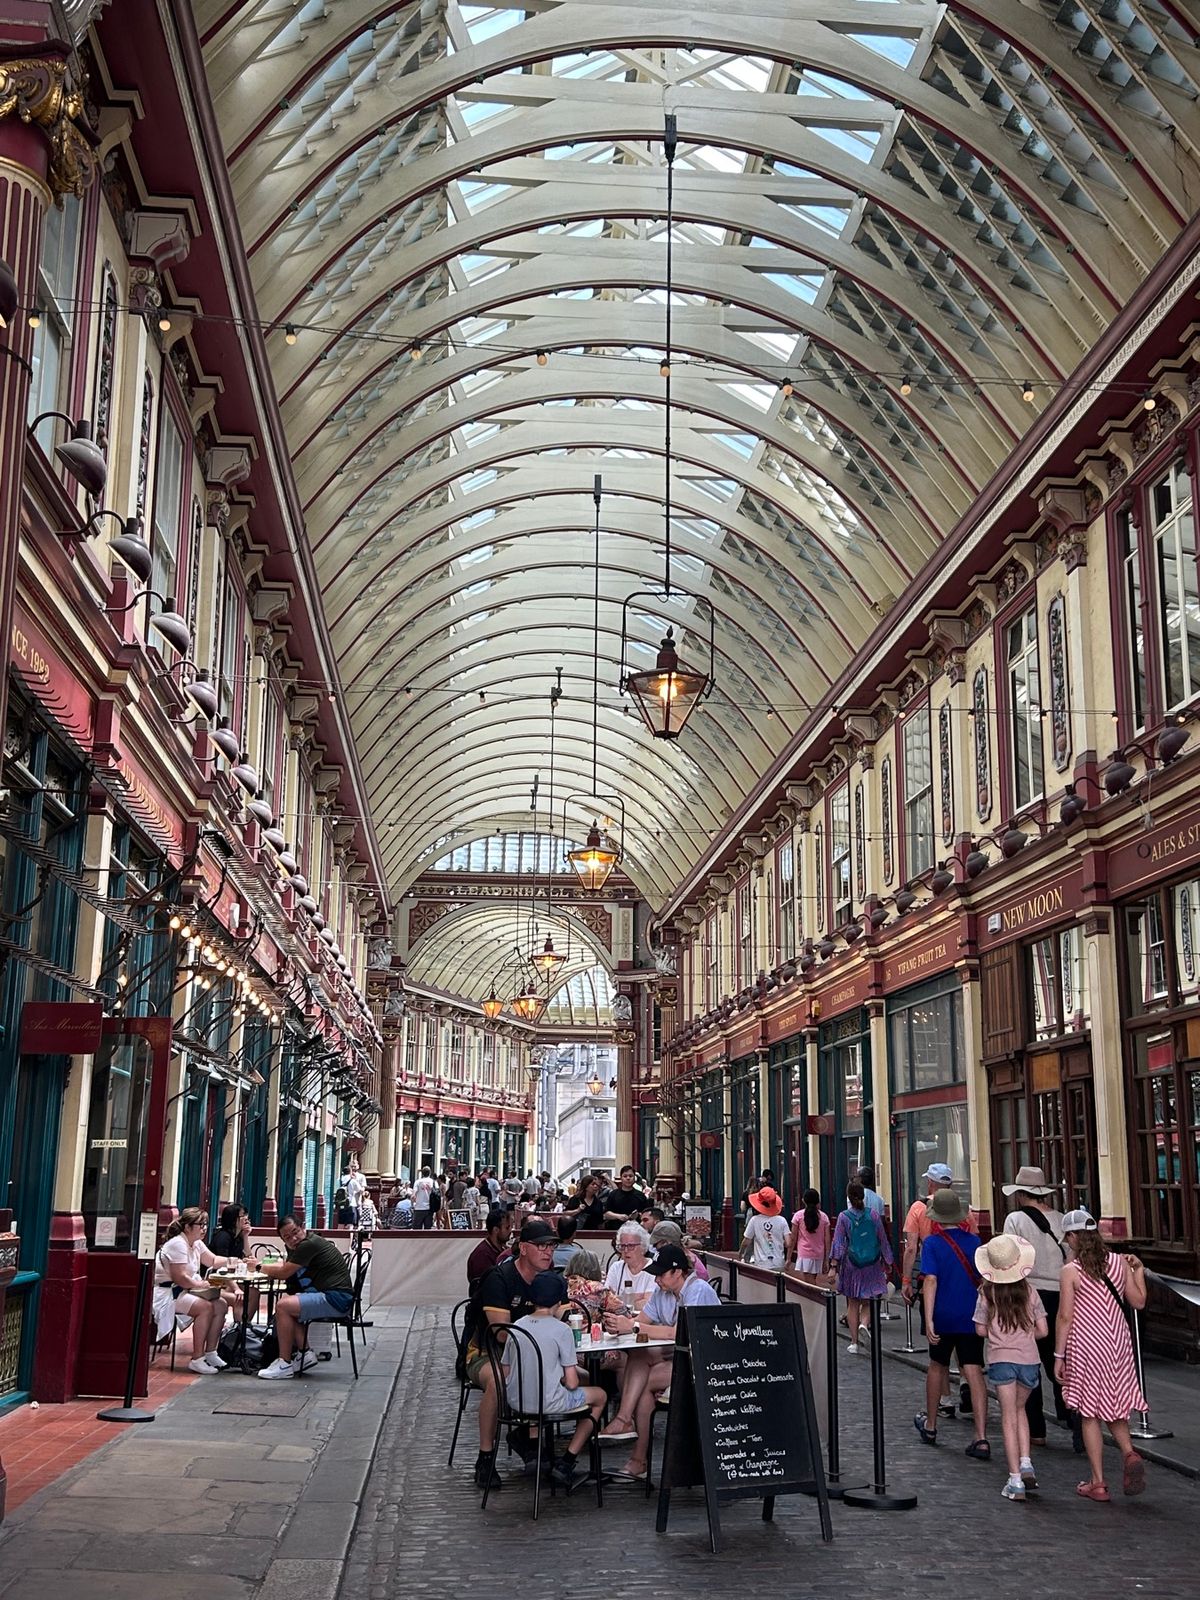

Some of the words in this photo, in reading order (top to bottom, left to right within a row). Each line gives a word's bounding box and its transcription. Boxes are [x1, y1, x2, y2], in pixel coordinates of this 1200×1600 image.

[1151, 835, 1176, 863] ALES
[1178, 831, 1187, 850] &
[456, 885, 570, 898] LEADENHALL
[1003, 902, 1026, 932] NEW
[1028, 885, 1063, 921] MOON
[897, 956, 917, 976] YIFANG
[917, 948, 935, 968] FRUIT
[935, 943, 947, 960] TEA
[712, 1324, 729, 1339] Aux
[716, 1423, 749, 1434] Sandwiches
